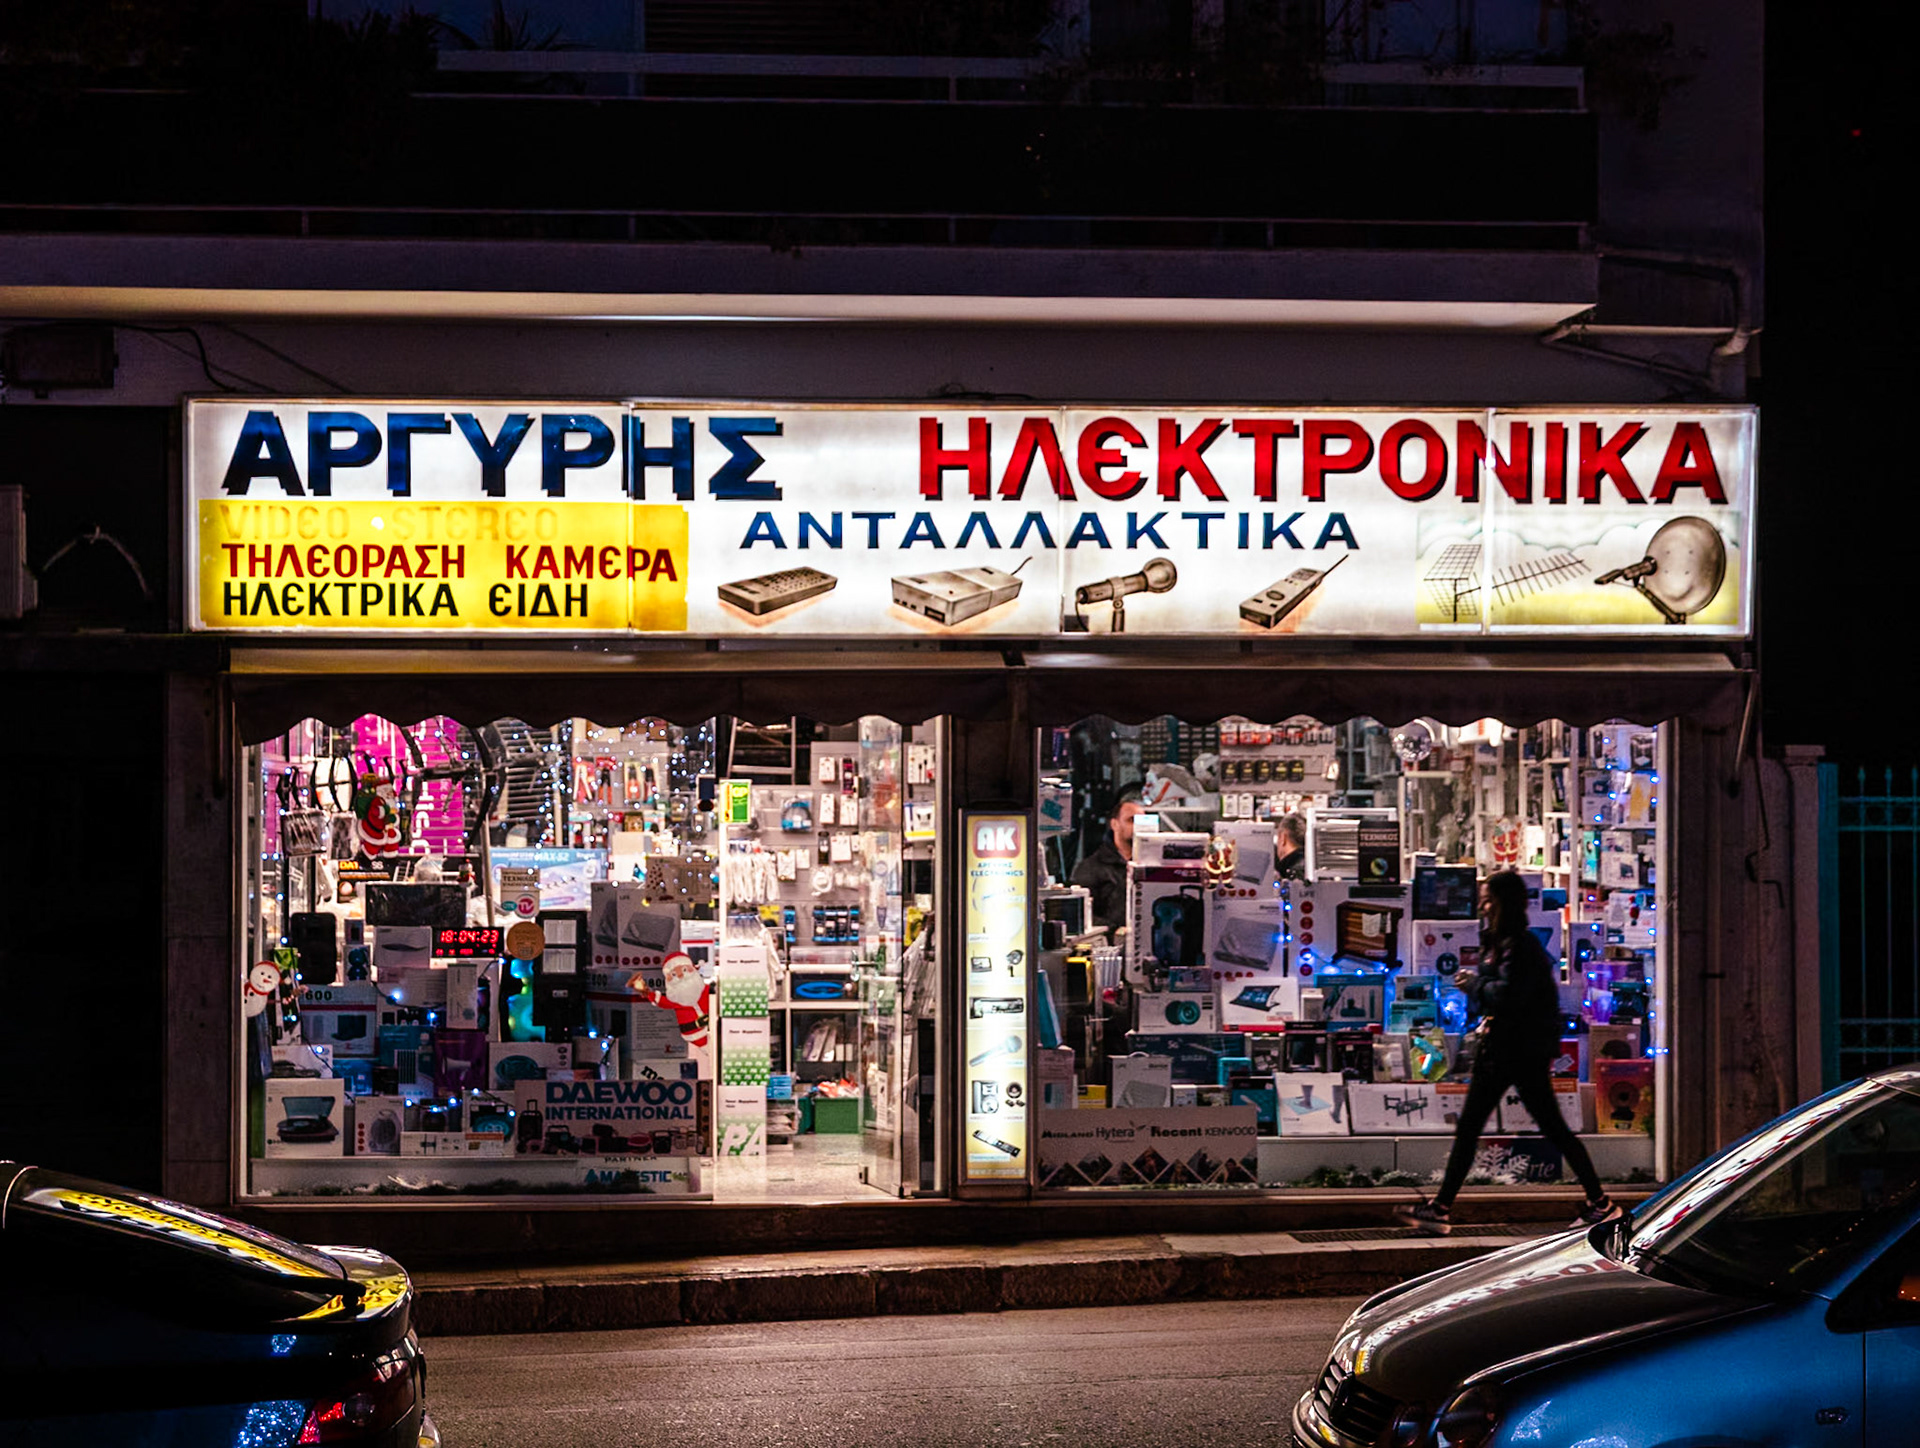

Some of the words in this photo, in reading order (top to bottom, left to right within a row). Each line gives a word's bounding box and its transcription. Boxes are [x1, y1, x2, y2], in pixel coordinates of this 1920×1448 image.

[221, 411, 783, 501] ΑΡΓΥΡΗΣ
[918, 416, 1728, 505] ΗΛΕΚΤΡΟΝΙΚΑ
[740, 510, 1360, 550] ΑΝΤΑΛΛΑΚΤΙΚΑ
[221, 543, 465, 578] ΤΗΛΕΟΡΑΣΗ
[505, 544, 679, 582] ΚΑΜΕΡΑ
[223, 582, 459, 616] ΗΛΕΚΤΡΙΚΑ
[488, 582, 588, 617] ΕΙΔΗ
[977, 827, 1016, 850] AK
[441, 930, 499, 943] 18:04:23
[546, 1081, 693, 1104] DAEWOO
[545, 1106, 694, 1120] INTERNATIONAL
[1096, 1127, 1134, 1140] Hytera
[1205, 1127, 1256, 1136] KENWOOD
[600, 1170, 671, 1183] MASTIC
